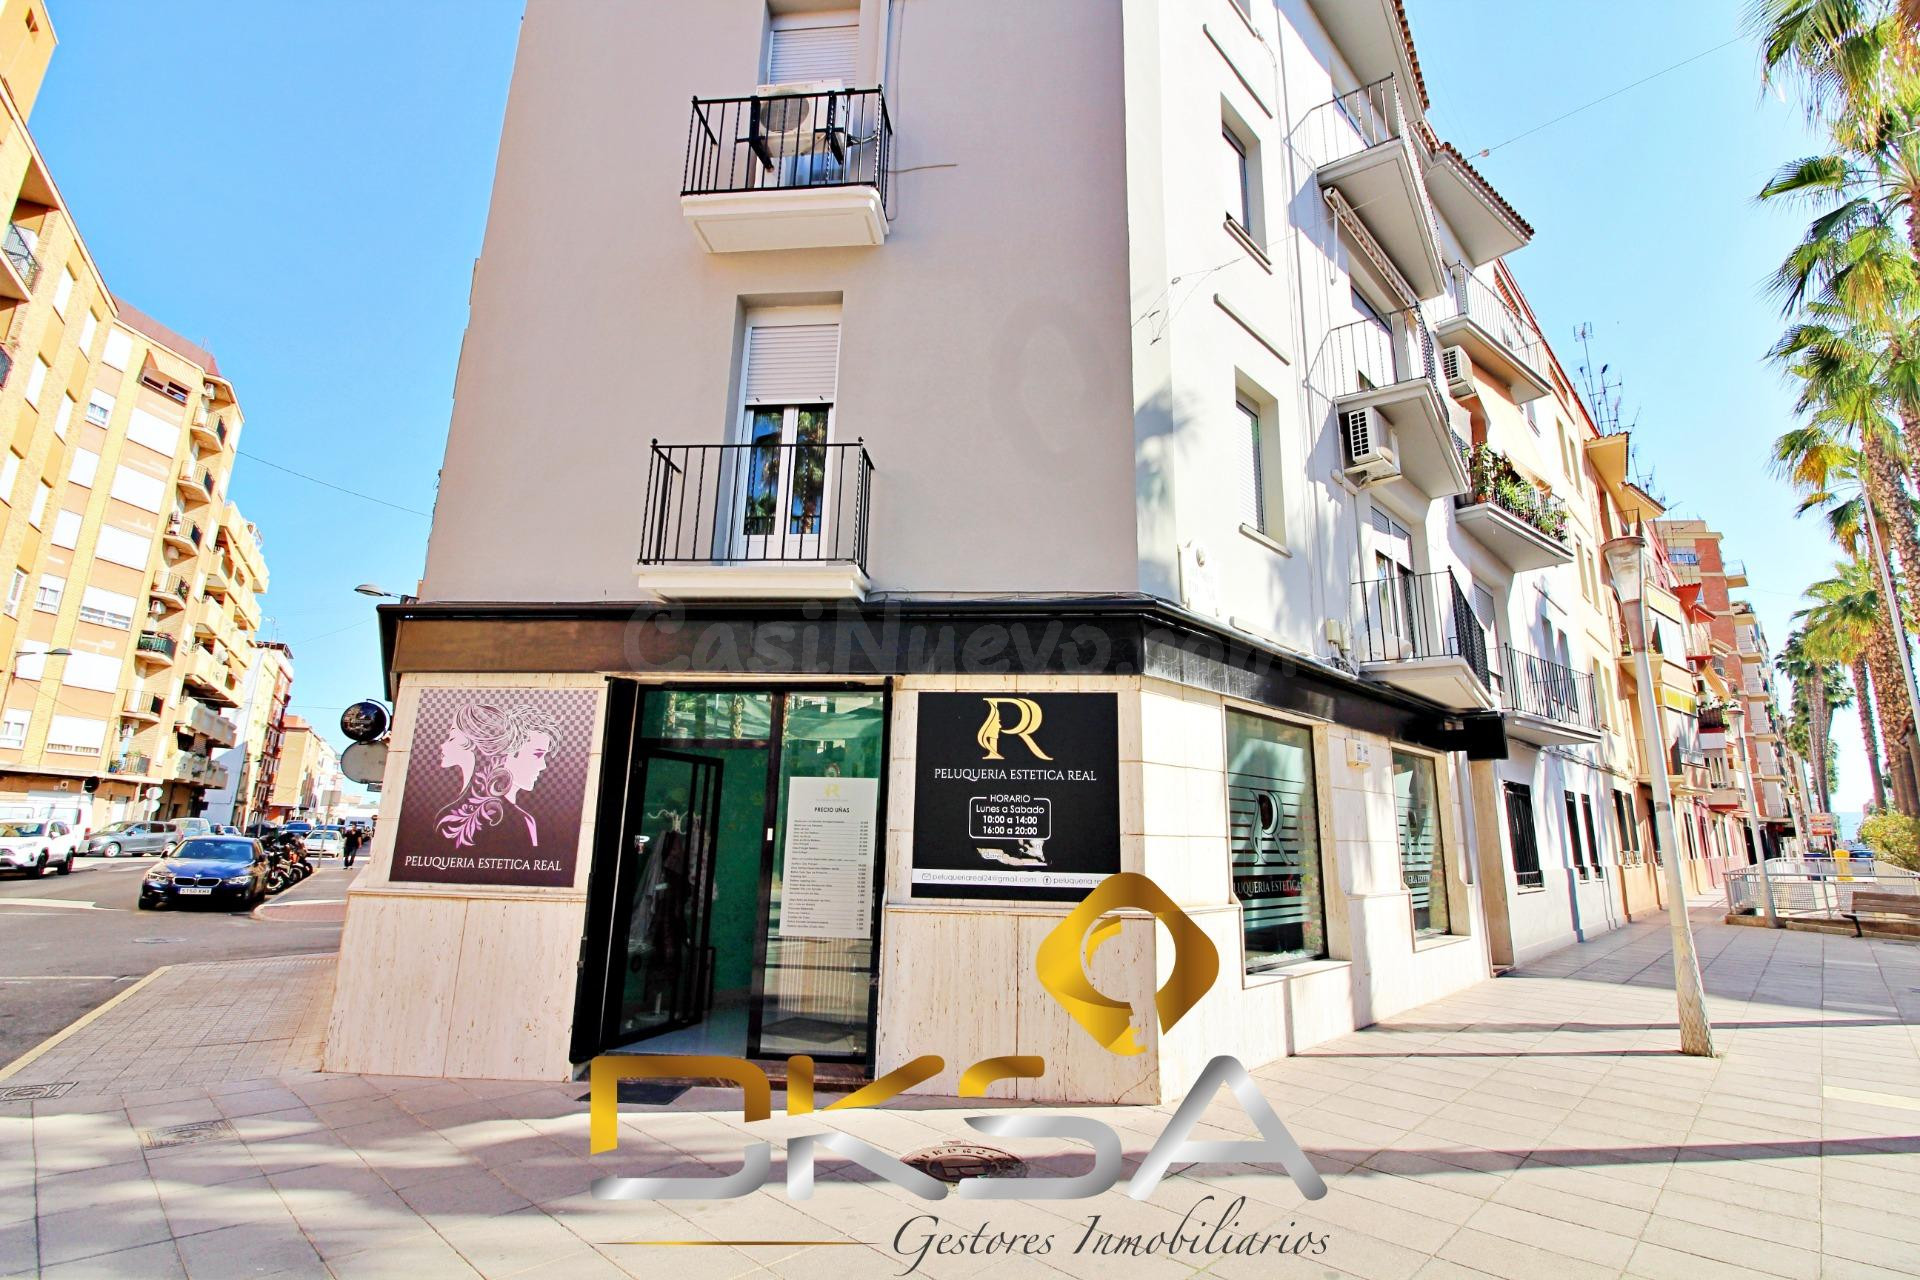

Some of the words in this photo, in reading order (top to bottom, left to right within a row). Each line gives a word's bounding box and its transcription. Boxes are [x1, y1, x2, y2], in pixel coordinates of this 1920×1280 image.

[934, 768, 1007, 782] PELUQUERIA
[1010, 769, 1064, 780] ESTETICA
[1068, 770, 1097, 781] REAL
[990, 794, 1031, 803] HORARIO
[976, 804, 1000, 813] Lunes
[1010, 805, 1045, 814] Sabado
[983, 815, 1005, 824] 10:00
[1016, 816, 1038, 824] 14:00
[983, 826, 1005, 834] 16:00
[1015, 827, 1038, 835] 20:00
[404, 855, 475, 870] PELUQUERIA
[478, 858, 530, 871] ESTETICA
[533, 859, 562, 871] REAL
